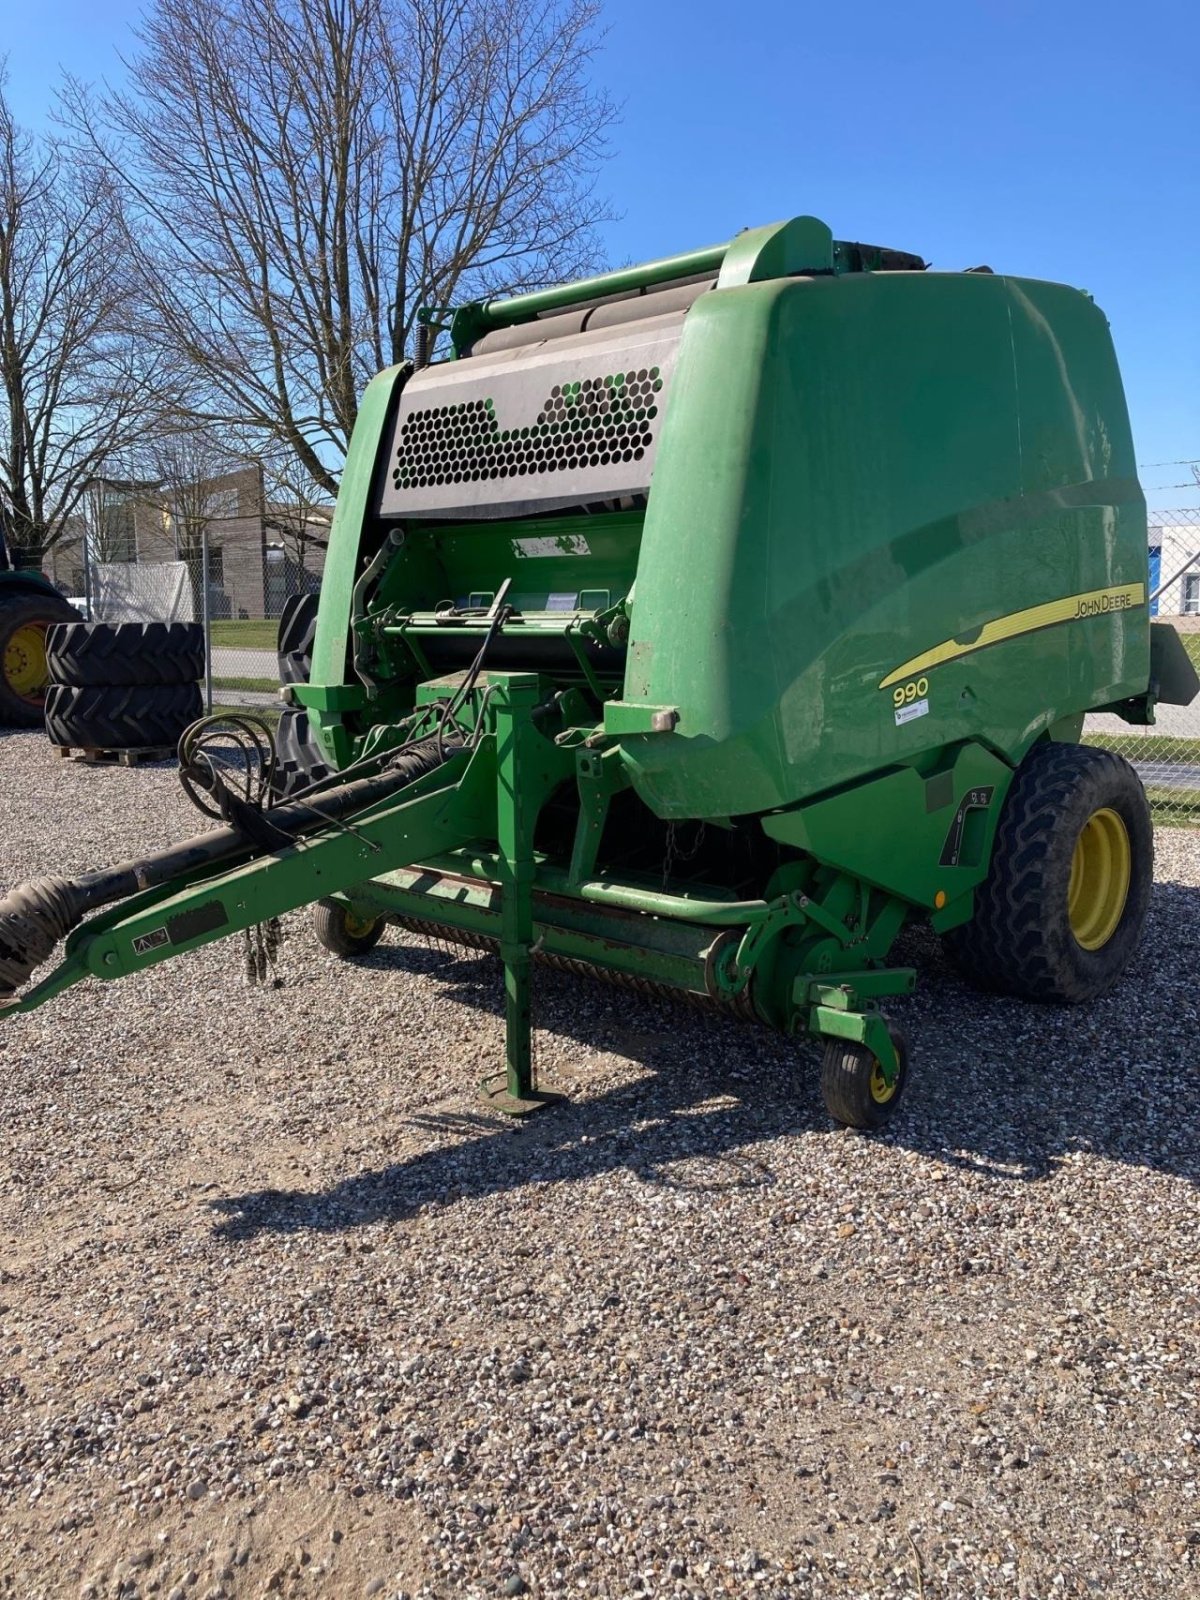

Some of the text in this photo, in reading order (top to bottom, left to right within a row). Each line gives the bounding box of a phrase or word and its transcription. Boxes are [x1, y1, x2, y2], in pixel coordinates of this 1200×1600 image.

[1074, 594, 1131, 617] JOHN DEERE
[893, 677, 929, 708] 990
